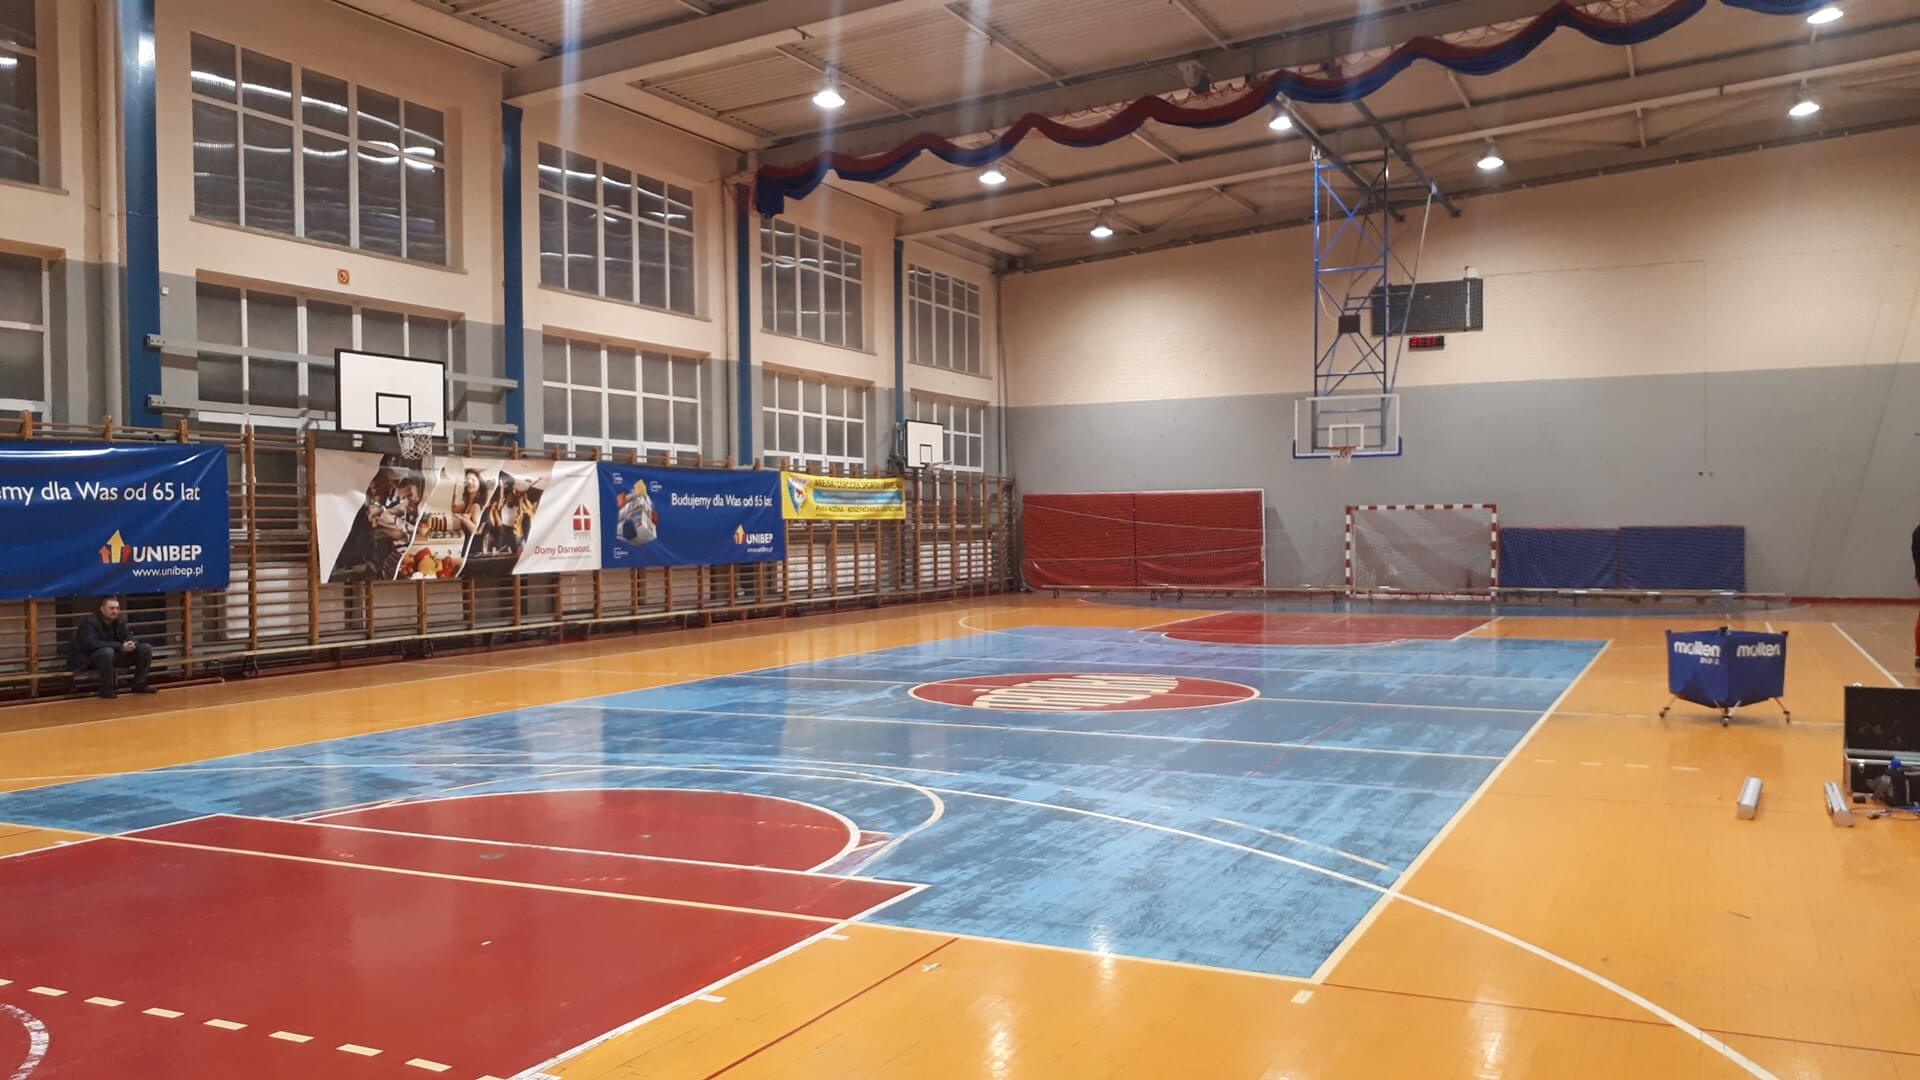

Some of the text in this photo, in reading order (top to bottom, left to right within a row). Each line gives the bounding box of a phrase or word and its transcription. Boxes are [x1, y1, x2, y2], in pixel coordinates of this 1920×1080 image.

[41, 481, 72, 501] dla
[75, 481, 119, 501] Was
[124, 482, 146, 501] od
[152, 482, 175, 501] 65
[181, 483, 200, 501] lat
[671, 492, 711, 509] Budujemy
[713, 494, 724, 506] dla
[725, 494, 742, 507] Was
[743, 495, 753, 506] od
[746, 533, 774, 545] UNIBEP
[132, 545, 202, 562] UNIBEP
[535, 545, 556, 556] Domy
[132, 565, 203, 578] www.unibep.pl
[1674, 640, 1720, 657] molten
[1736, 642, 1780, 657] molten
